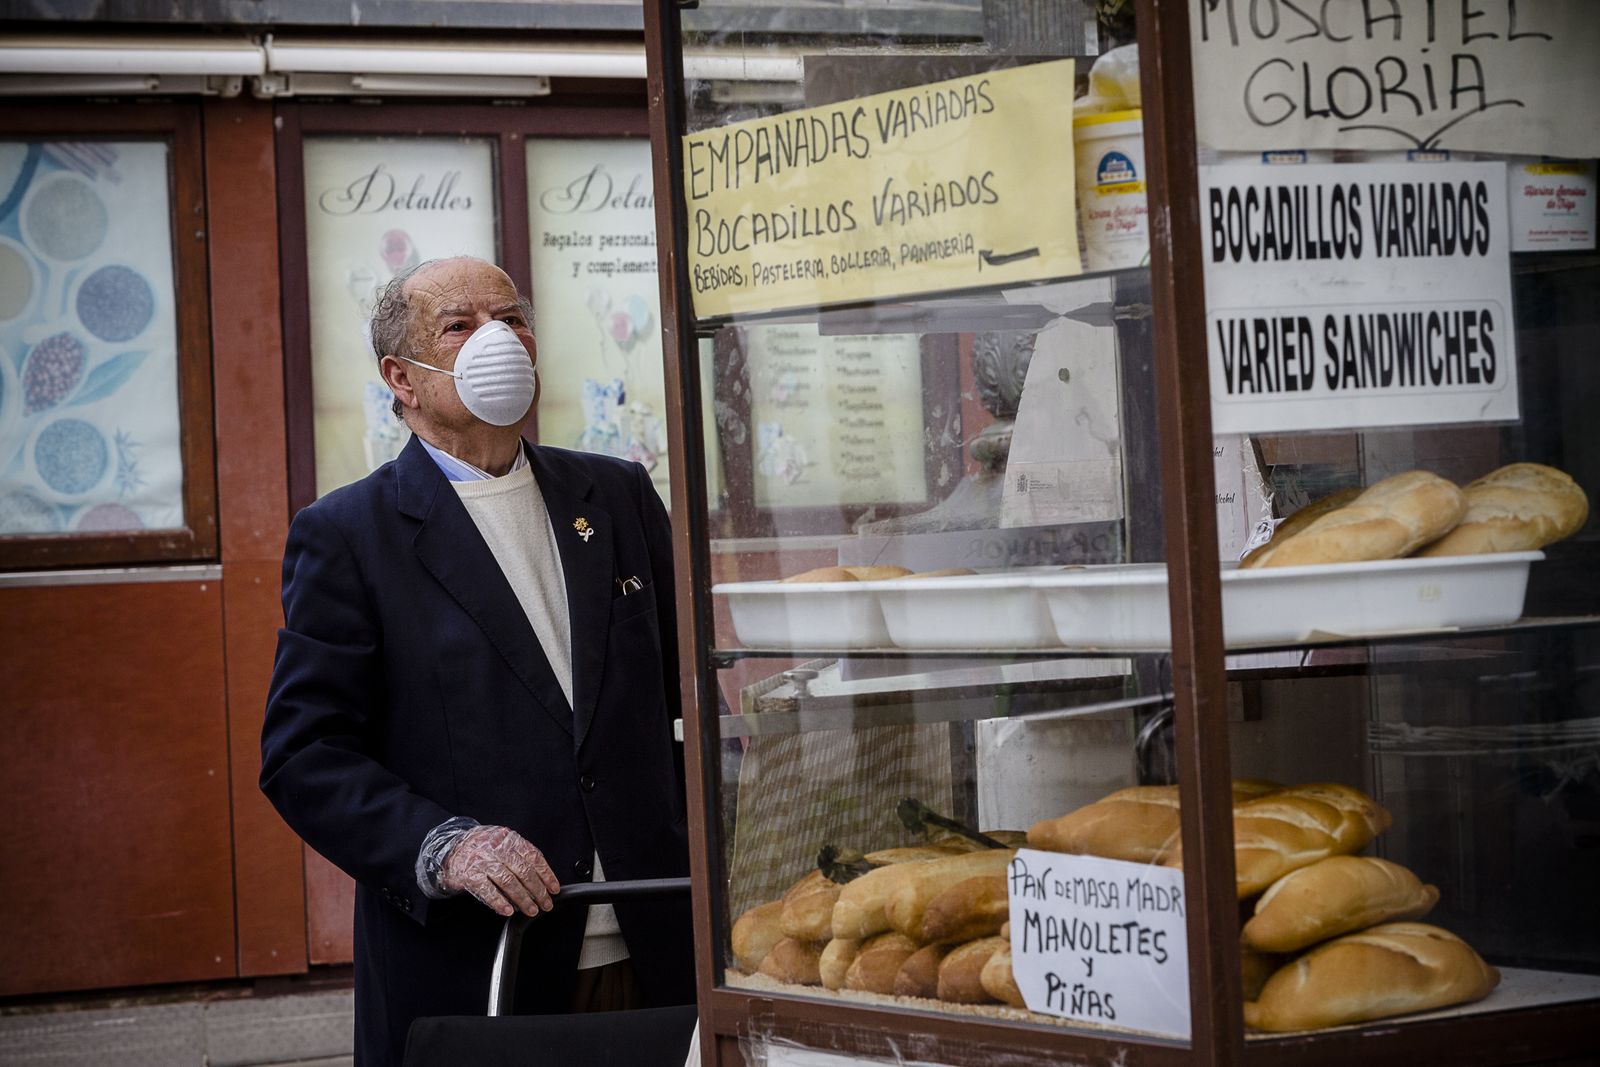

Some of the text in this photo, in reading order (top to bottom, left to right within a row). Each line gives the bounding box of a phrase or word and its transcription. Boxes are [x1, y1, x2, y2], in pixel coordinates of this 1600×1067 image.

[688, 106, 871, 200] EMPANADAS
[319, 163, 473, 216] Detalles
[543, 231, 592, 251] Regalos
[1209, 180, 1490, 263] BOCADILLOS VARIADOS
[572, 261, 581, 278] y
[1216, 308, 1496, 394] VARIED SANDWICHES
[1010, 857, 1052, 901] PAN
[1023, 908, 1168, 964] MANOLETES
